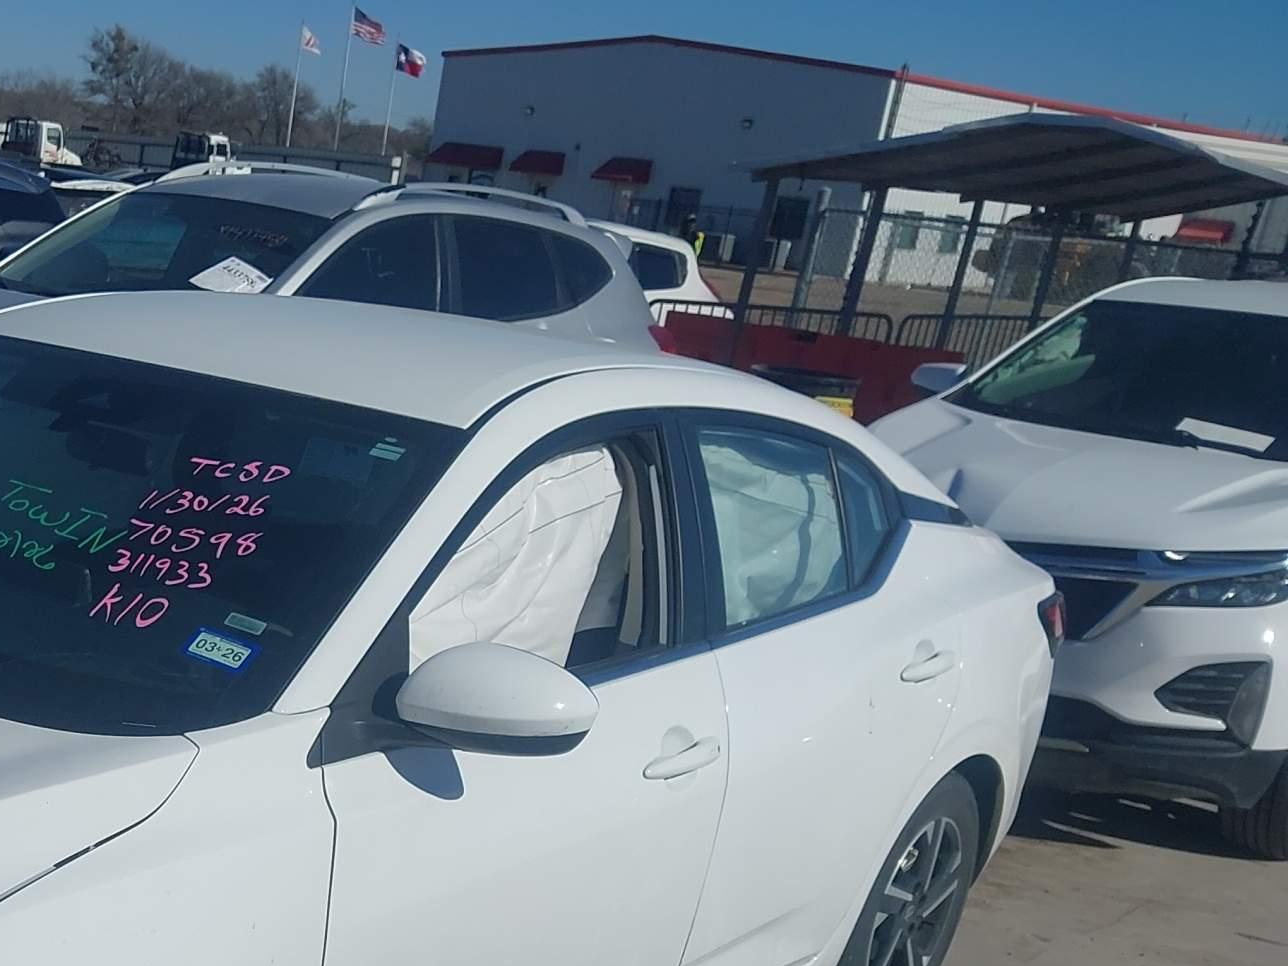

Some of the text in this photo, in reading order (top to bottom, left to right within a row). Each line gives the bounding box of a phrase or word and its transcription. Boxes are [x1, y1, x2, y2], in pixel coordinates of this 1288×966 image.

[189, 456, 292, 484] TCSD
[138, 488, 271, 517] 1/30/26
[128, 518, 265, 560] 70598
[107, 549, 213, 589] 311933
